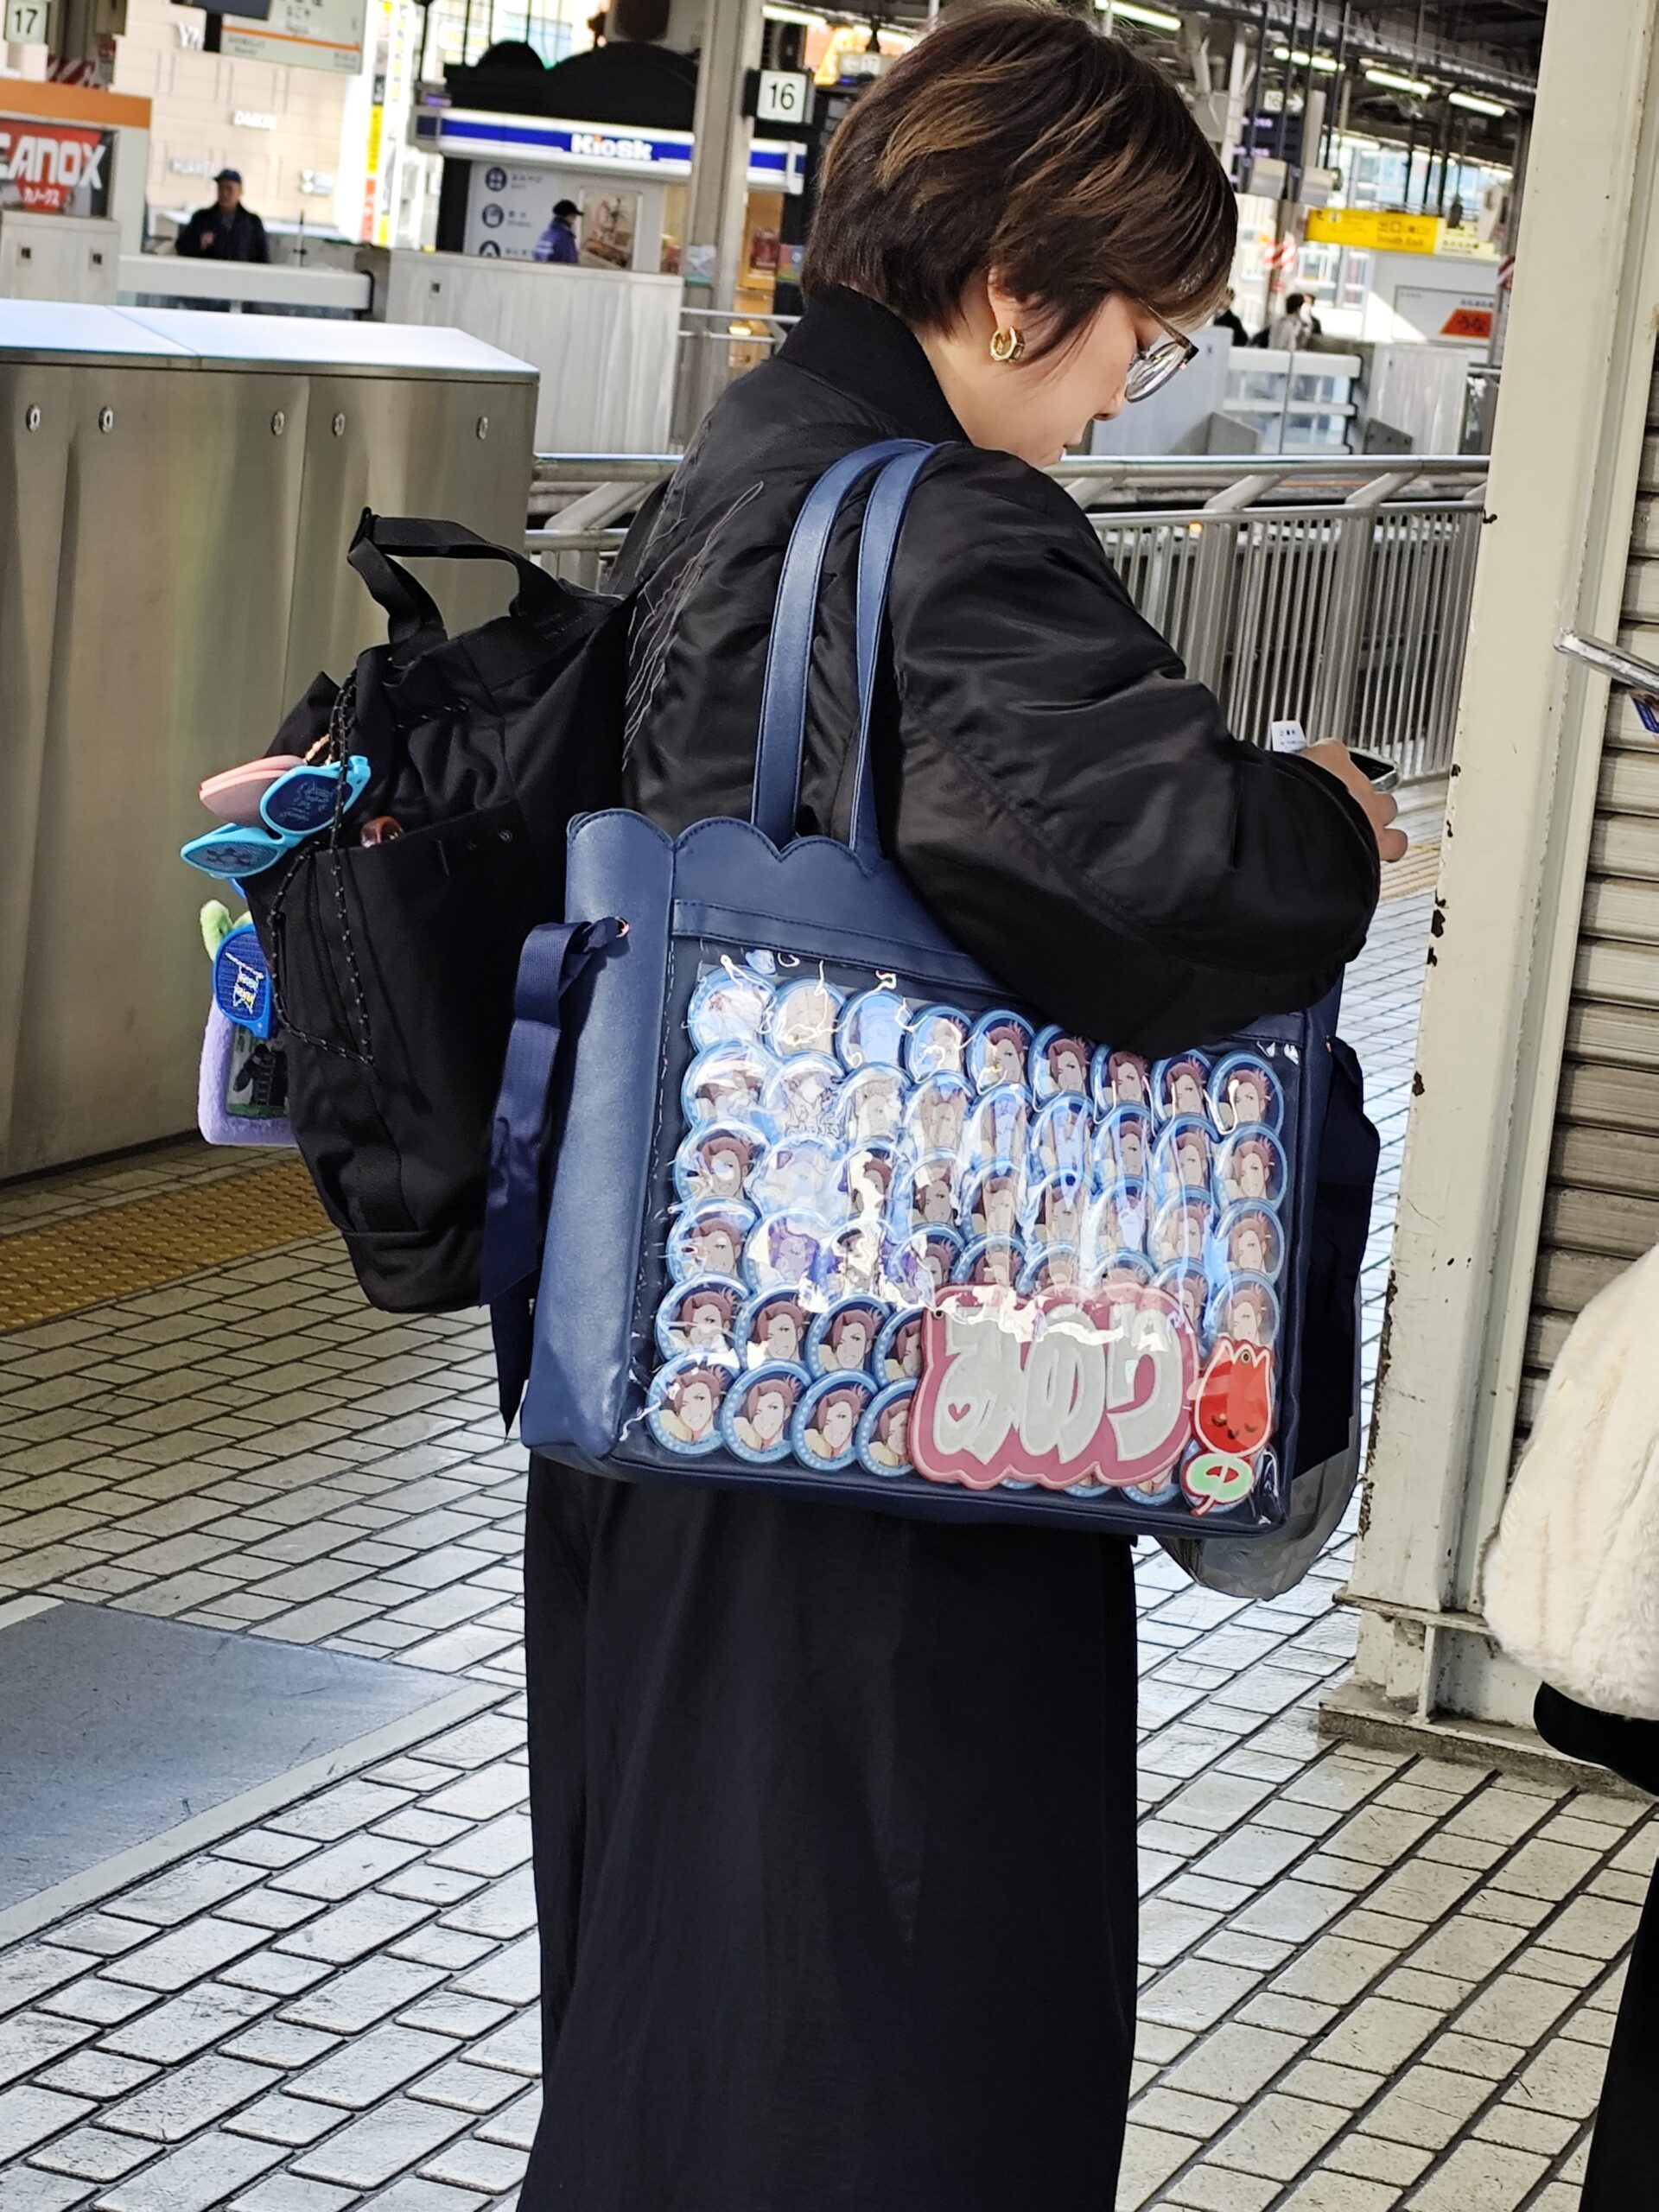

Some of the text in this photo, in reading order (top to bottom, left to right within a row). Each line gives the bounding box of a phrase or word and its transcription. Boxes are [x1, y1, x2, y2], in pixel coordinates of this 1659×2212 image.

[15, 9, 39, 34] 17
[769, 83, 796, 111] 16
[570, 133, 653, 162] Kiosk
